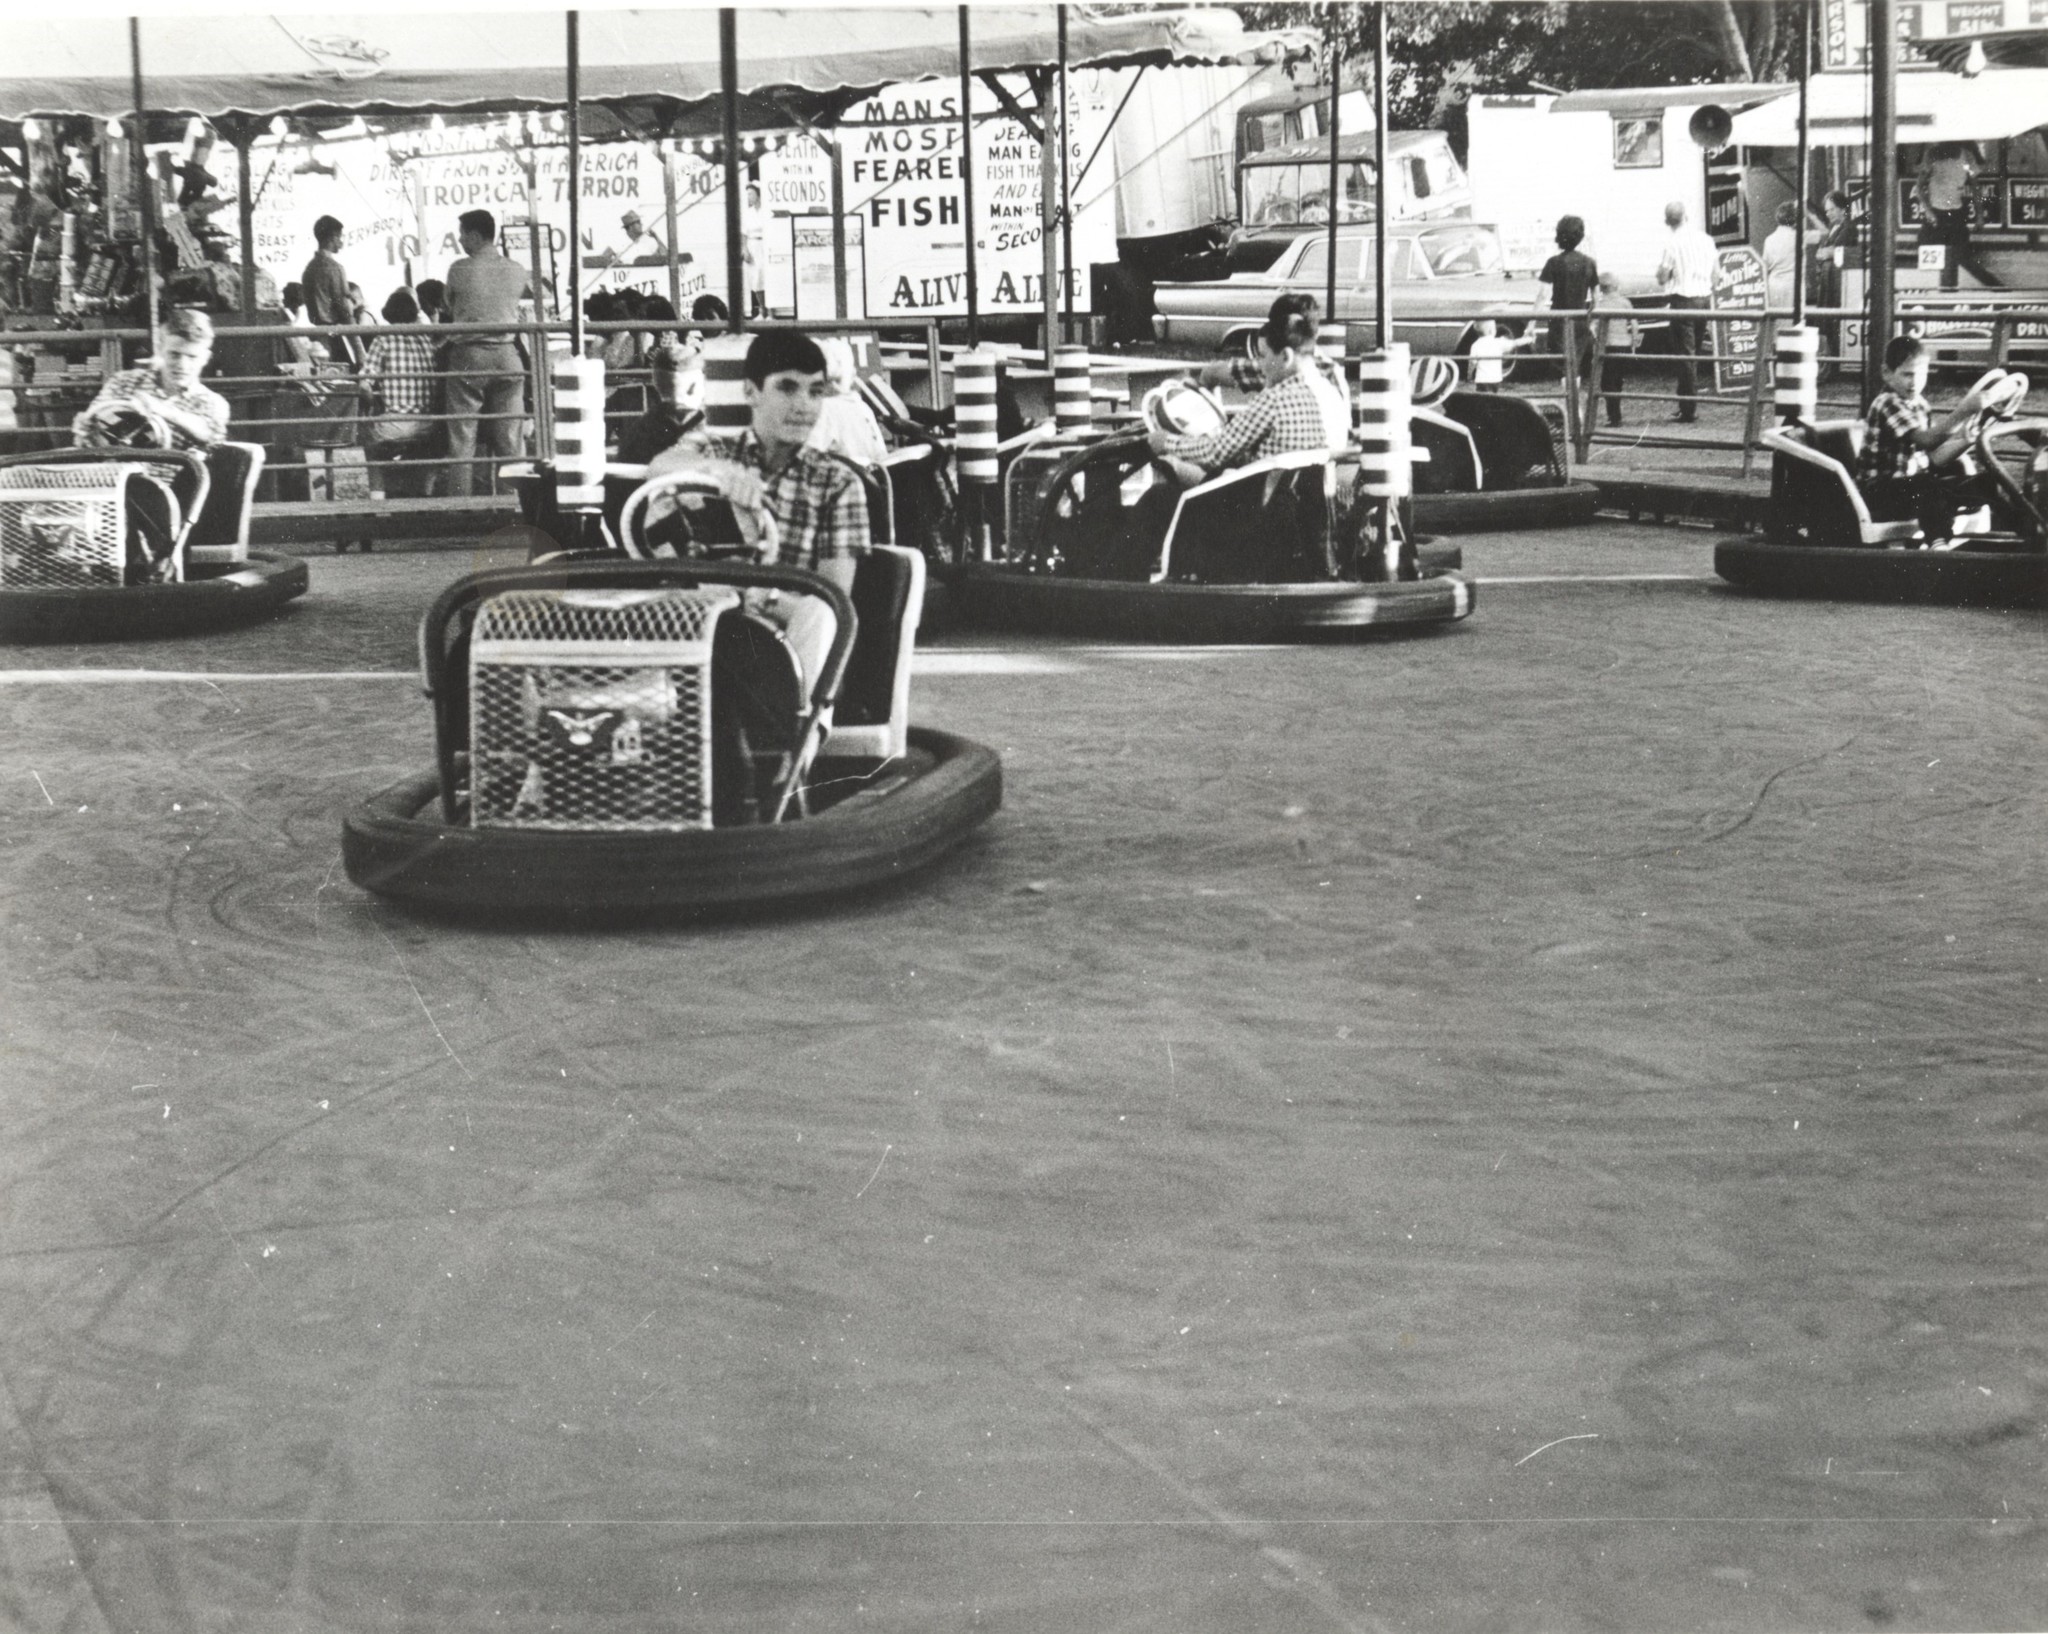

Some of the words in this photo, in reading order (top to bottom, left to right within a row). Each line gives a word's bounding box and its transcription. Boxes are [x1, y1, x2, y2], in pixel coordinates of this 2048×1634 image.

[864, 97, 957, 121] MANS
[864, 127, 957, 153] MOST
[988, 145, 1022, 161] MAN
[370, 157, 432, 182] DIRET
[558, 151, 639, 173] AERICA
[987, 164, 1014, 180] FISH
[1020, 164, 1045, 179] THA
[421, 179, 542, 207] TROPICA
[552, 174, 640, 203] TRROR
[768, 181, 826, 203] SECONDS
[993, 183, 1027, 199] AND
[870, 195, 959, 227] FISH
[990, 203, 1022, 218] MAN
[1711, 195, 1738, 226] HIM
[258, 234, 296, 247] BEAST
[889, 271, 968, 307] ALIV
